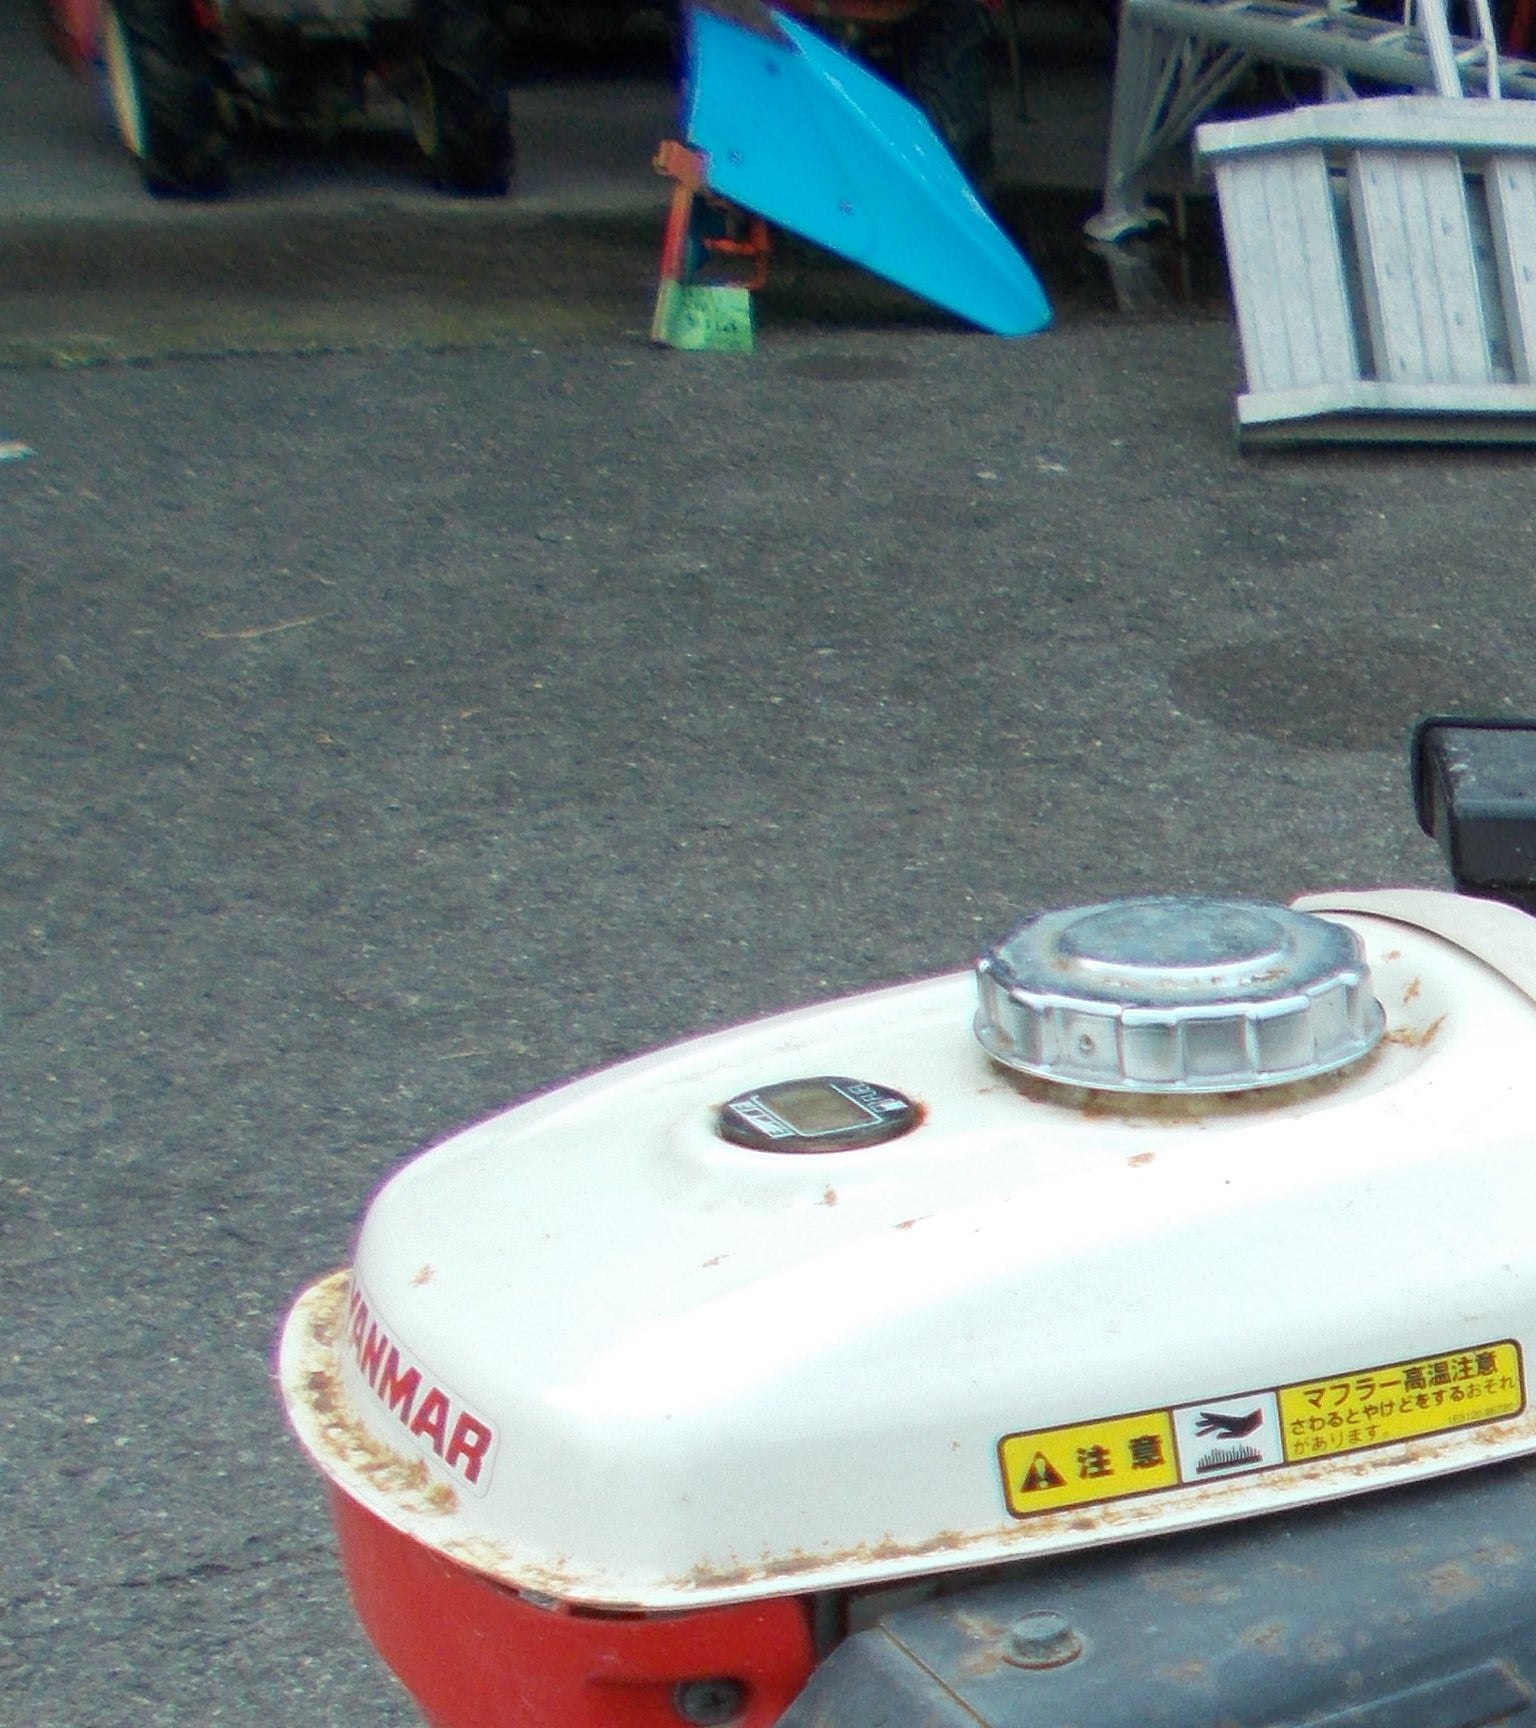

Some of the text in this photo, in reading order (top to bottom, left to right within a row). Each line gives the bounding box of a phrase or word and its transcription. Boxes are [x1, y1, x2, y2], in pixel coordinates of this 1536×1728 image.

[1289, 1375, 1517, 1436] さわるとやけどをするおそれ
[1303, 1350, 1500, 1410] マフラー高温注意
[1074, 1432, 1166, 1480] 注意
